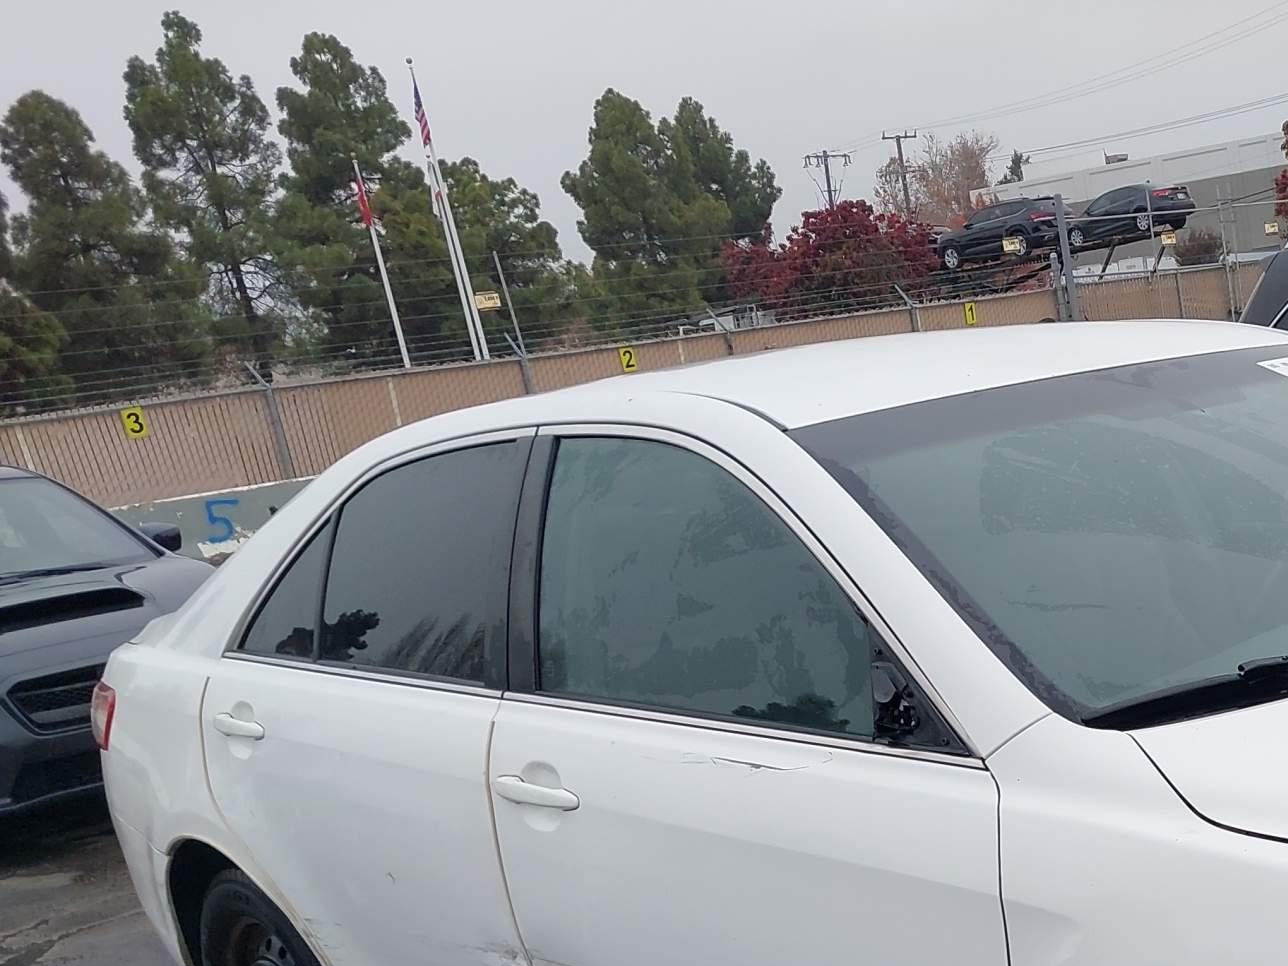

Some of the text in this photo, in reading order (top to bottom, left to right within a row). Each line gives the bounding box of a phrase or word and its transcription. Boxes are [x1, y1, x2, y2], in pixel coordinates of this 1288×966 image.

[967, 304, 975, 321] 1
[622, 349, 635, 369] 2
[126, 412, 144, 434] 3
[205, 499, 240, 544] 5
